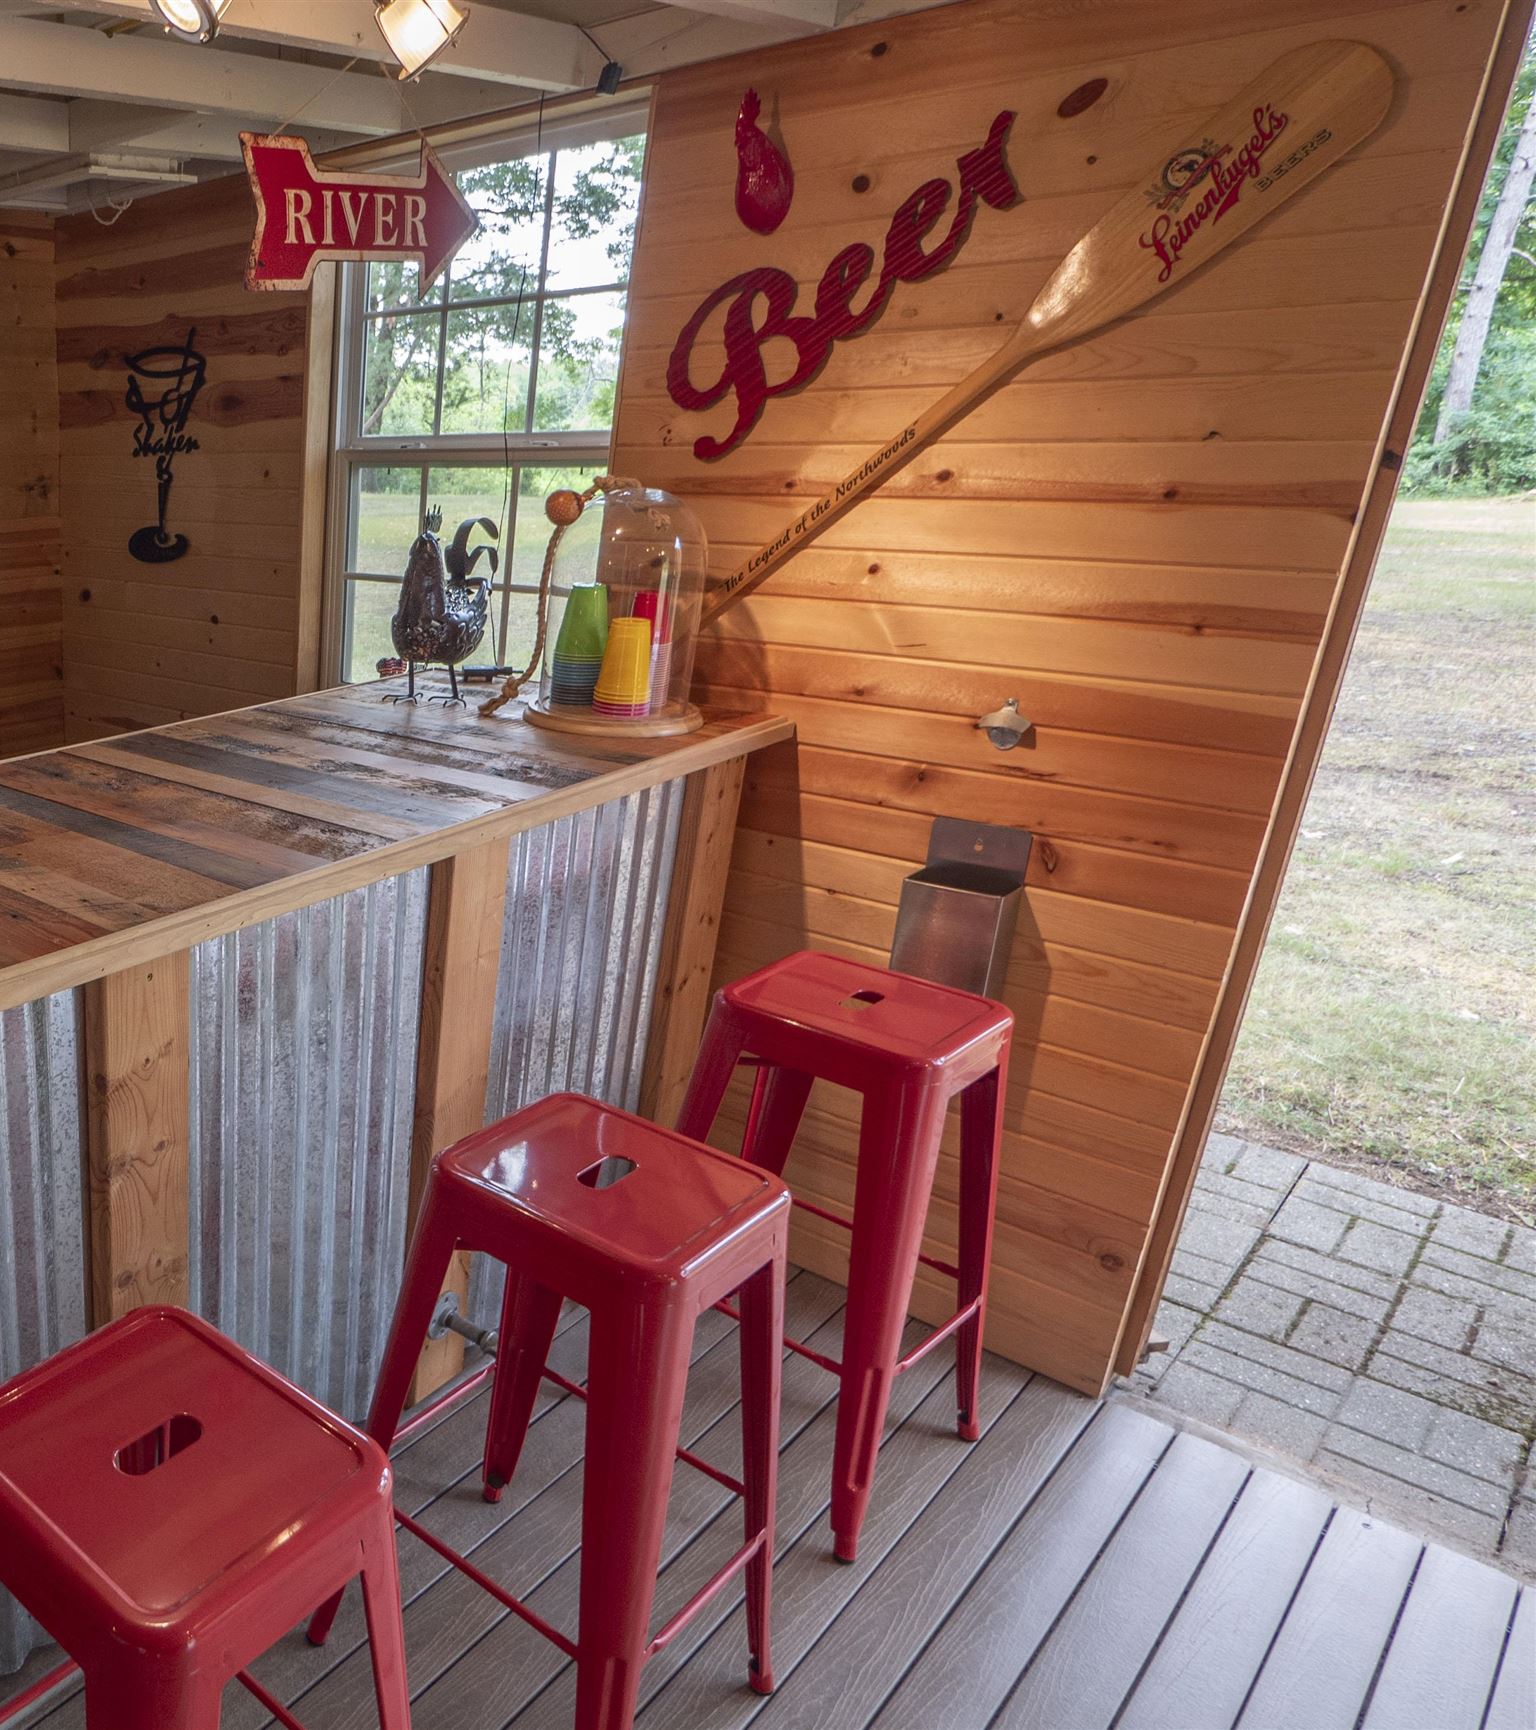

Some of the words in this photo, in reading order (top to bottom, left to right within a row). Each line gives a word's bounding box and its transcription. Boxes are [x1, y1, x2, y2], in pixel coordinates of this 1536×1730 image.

[1138, 102, 1289, 283] Leinenkugel's
[1254, 128, 1333, 193] BEERS
[283, 188, 428, 247] RIVER
[667, 110, 1017, 460] Beer
[133, 423, 201, 457] Shaken
[747, 529, 791, 573] Legend
[795, 516, 808, 533] of
[810, 499, 831, 521] the
